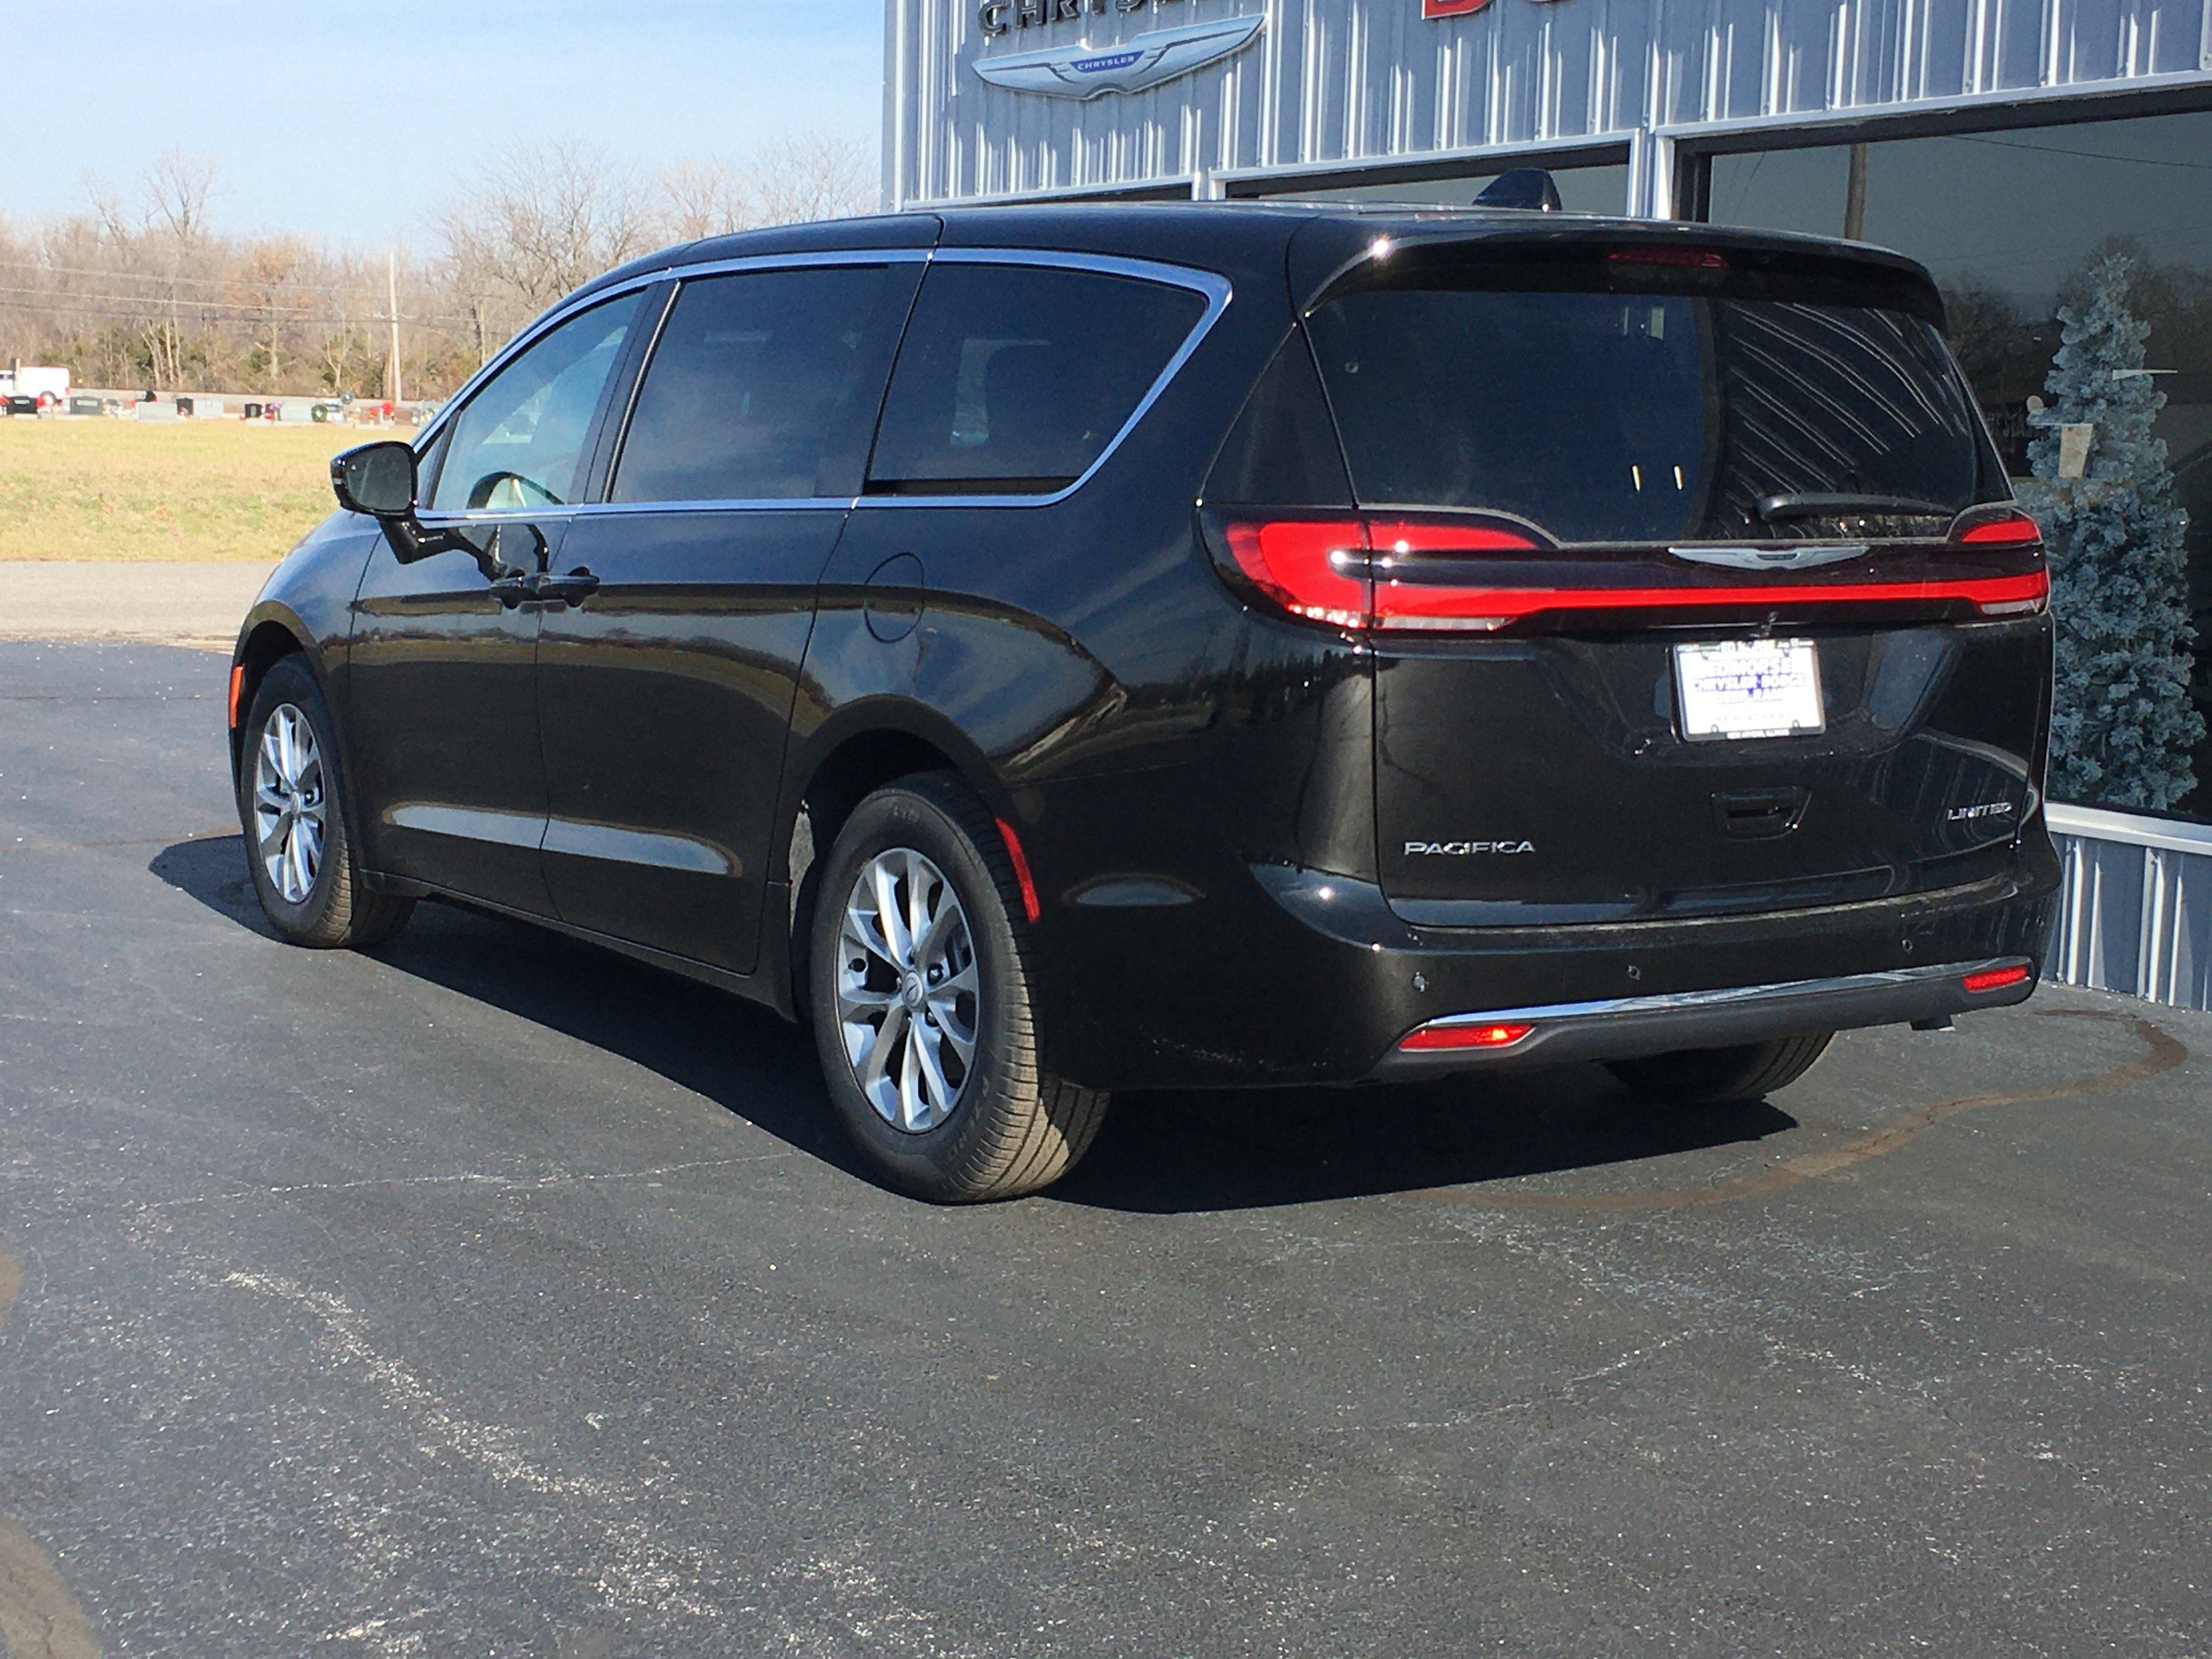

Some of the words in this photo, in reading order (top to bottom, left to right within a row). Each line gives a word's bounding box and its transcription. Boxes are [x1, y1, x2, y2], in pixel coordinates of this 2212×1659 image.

[1077, 55, 1135, 70] CHRYSLER
[1730, 657, 1792, 675] MORSE
[1403, 840, 1536, 856] PACIFICA
